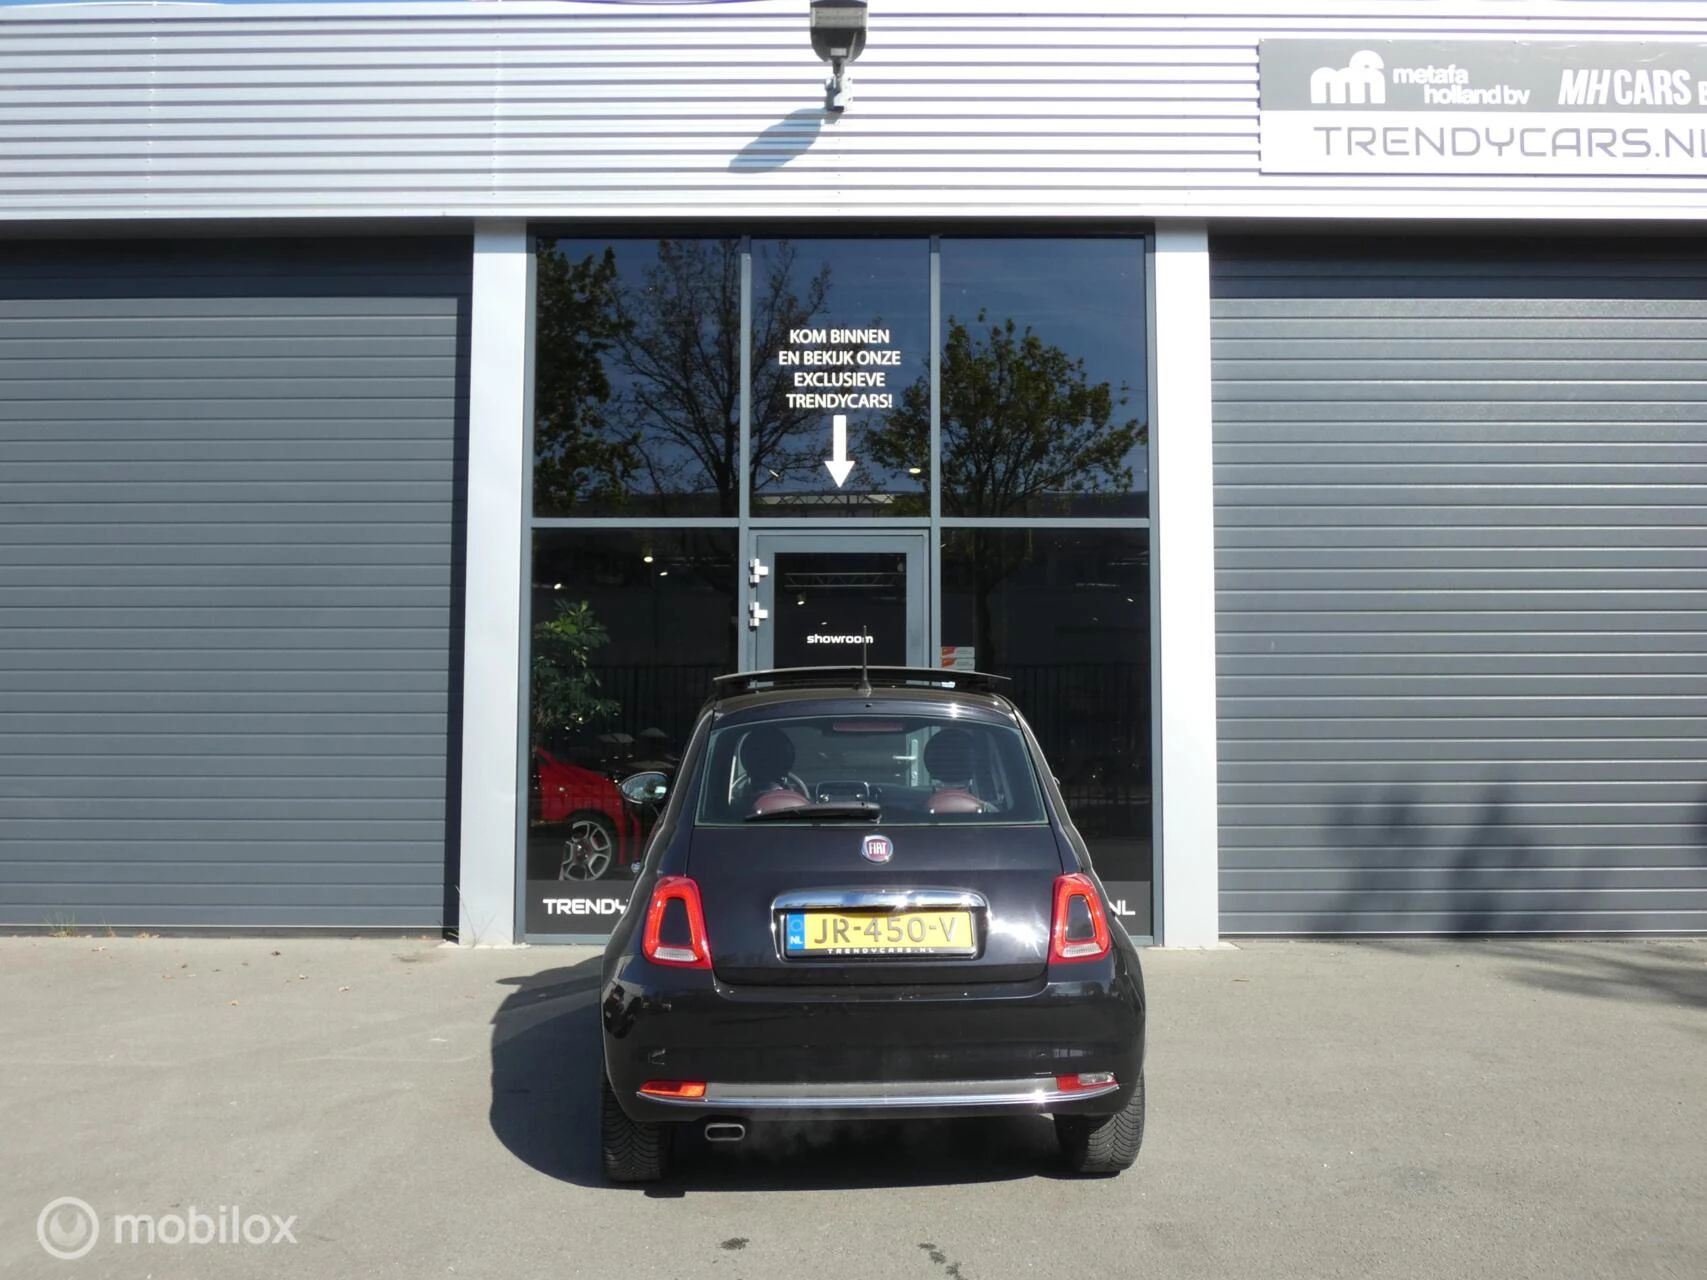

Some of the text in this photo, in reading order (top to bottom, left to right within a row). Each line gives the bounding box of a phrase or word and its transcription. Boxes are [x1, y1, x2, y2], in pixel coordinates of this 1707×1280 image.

[1393, 64, 1469, 84] metafa
[1424, 84, 1531, 104] holland bv
[789, 329, 890, 344] KOM BINNEN
[778, 351, 902, 366] EN BEKIJK ONZE
[794, 372, 886, 387] EXCLUSIEVE
[786, 394, 893, 409] TRENDYCARS!
[806, 633, 874, 644] showroom
[868, 842, 887, 855] FIAT
[790, 916, 957, 945] NL JR-450-V
[827, 947, 935, 955] TRENDYCARS.NL
